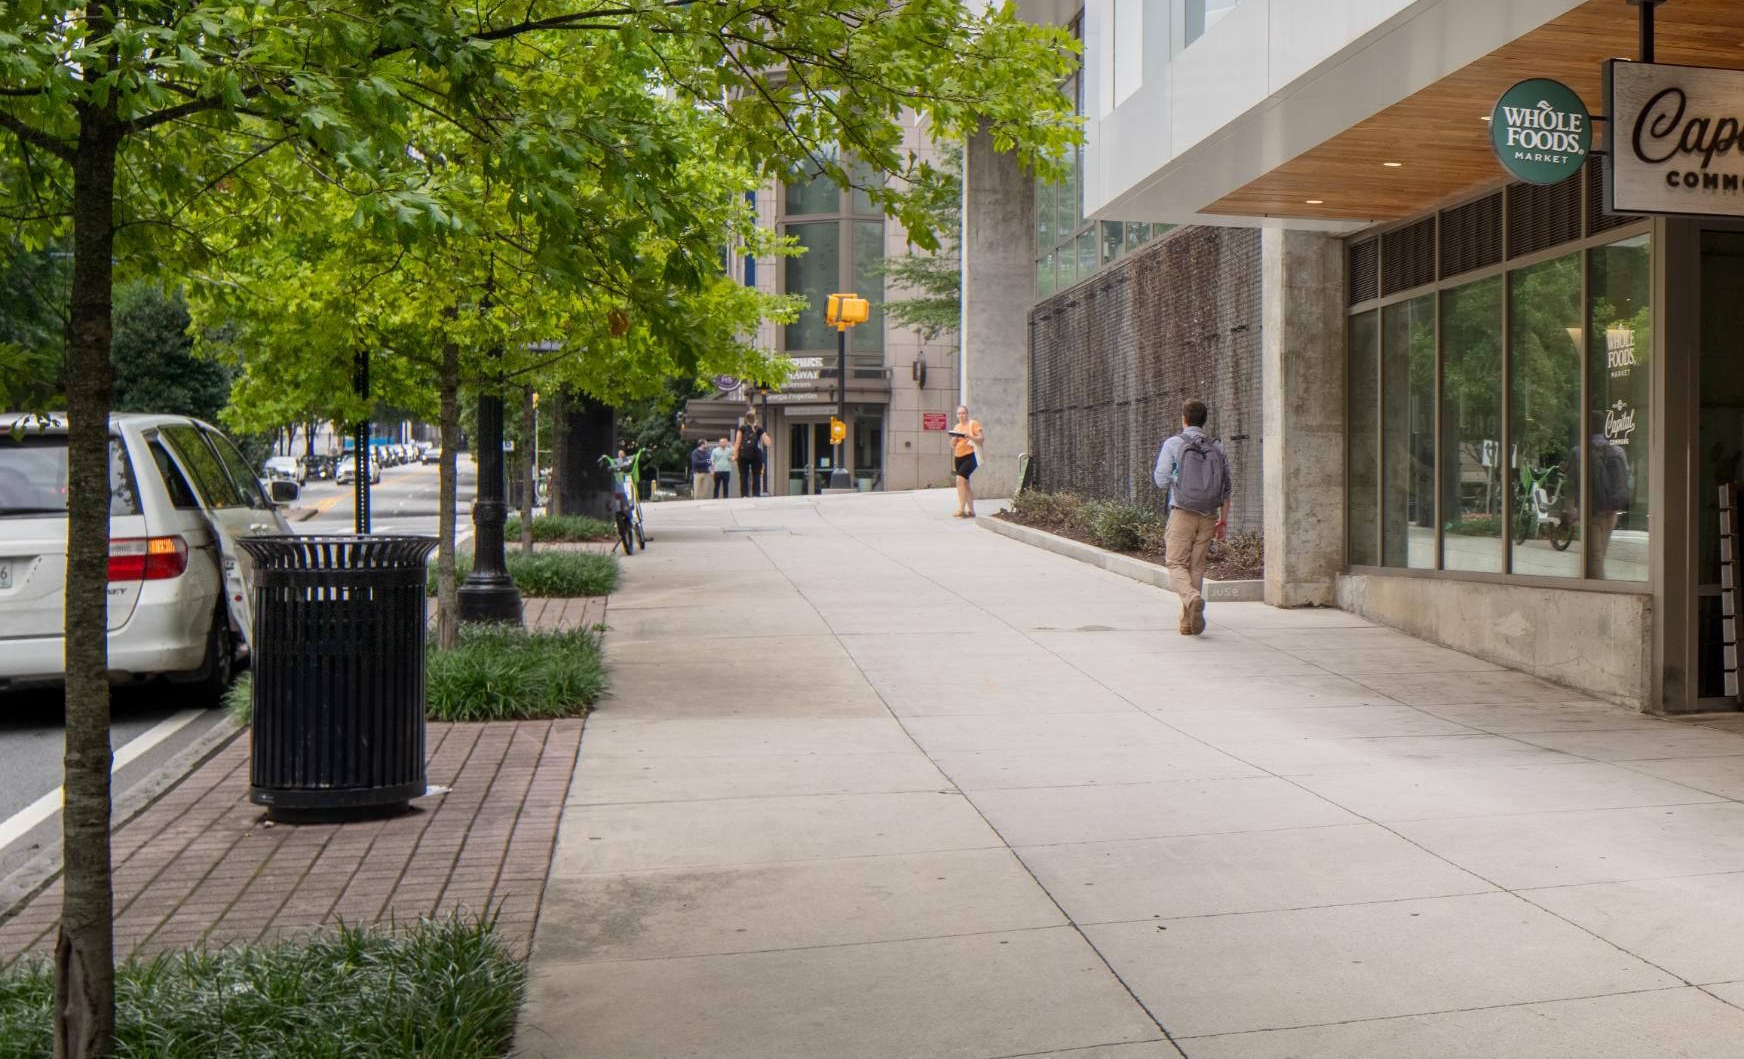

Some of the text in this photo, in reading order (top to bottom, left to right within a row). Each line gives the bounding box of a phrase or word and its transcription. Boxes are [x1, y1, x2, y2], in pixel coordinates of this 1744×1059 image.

[1503, 101, 1583, 133] WHOLE
[1507, 127, 1580, 154] FOODS
[1514, 151, 1569, 164] MARKET
[1607, 328, 1636, 351] WHOLE
[1607, 348, 1636, 369] FOODS
[1605, 408, 1635, 439] Capital
